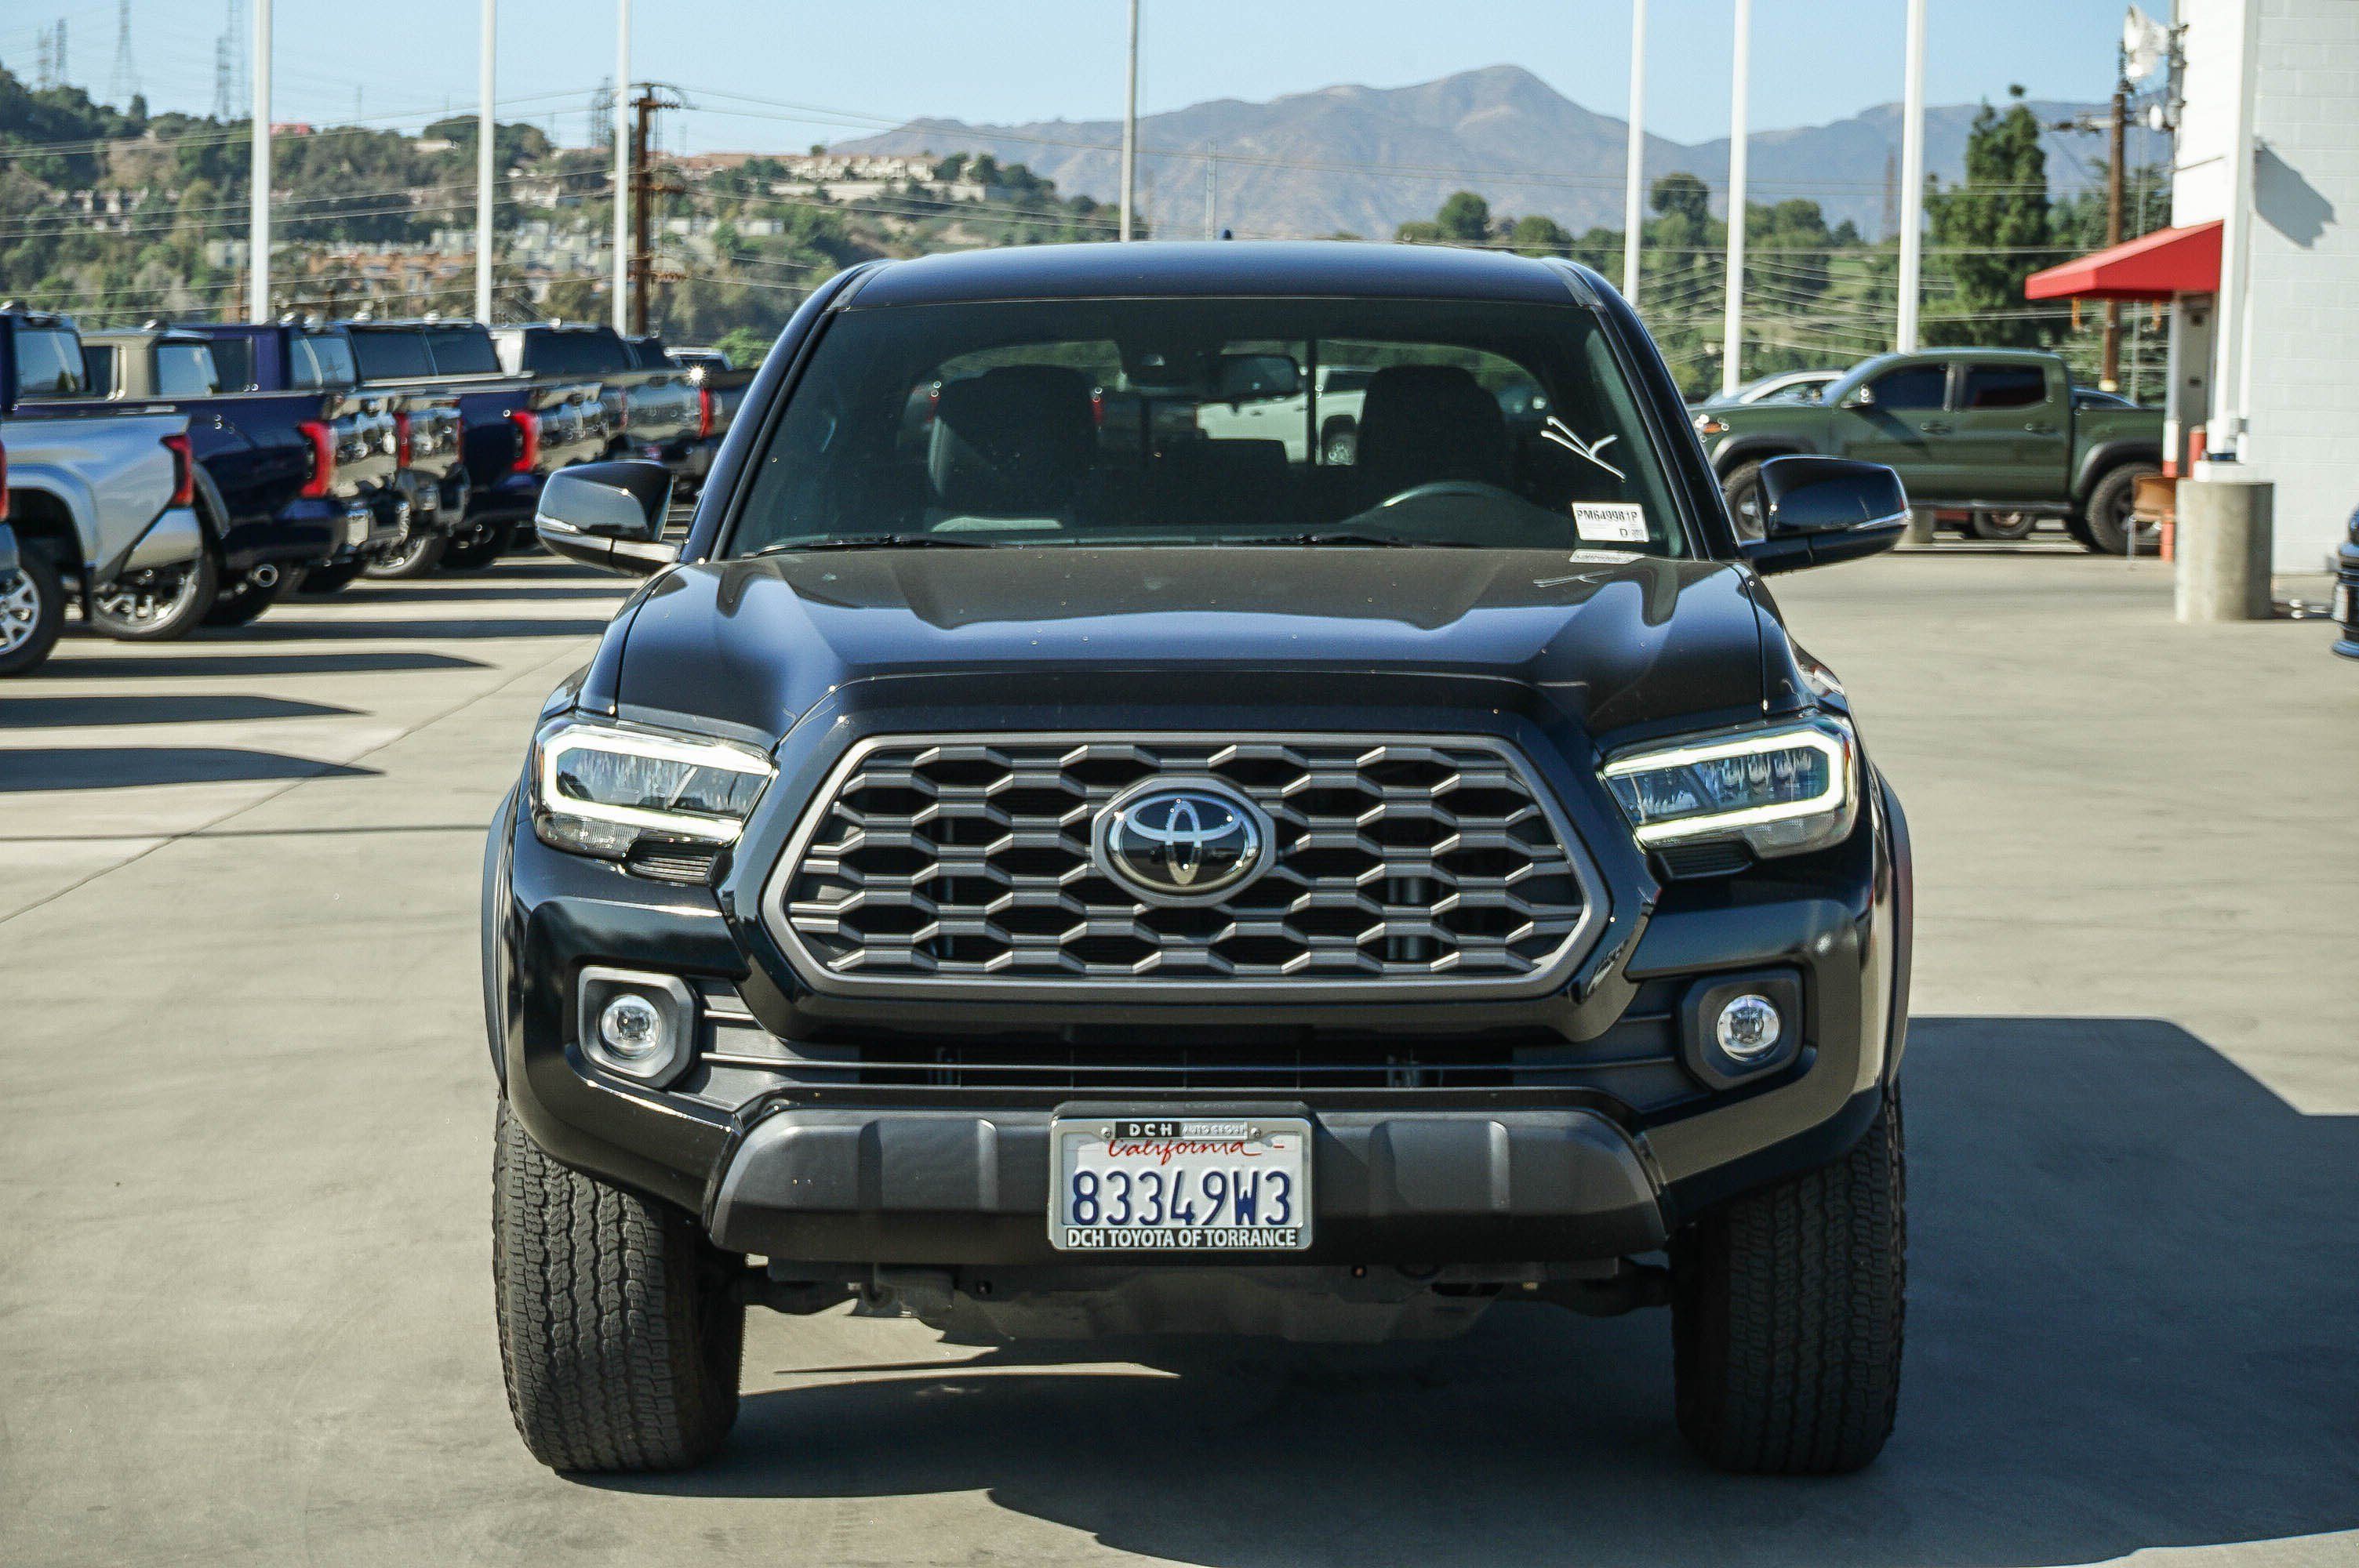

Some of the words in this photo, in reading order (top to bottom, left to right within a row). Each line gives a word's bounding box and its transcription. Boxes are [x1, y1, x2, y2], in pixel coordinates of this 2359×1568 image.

[1108, 1138, 1262, 1166] California
[1072, 1171, 1290, 1226] 83349W3
[1067, 1229, 1103, 1247] DCH
[1107, 1229, 1175, 1247] TOYOTA
[1178, 1229, 1201, 1247] OF
[1204, 1229, 1296, 1247] TORRANCE
